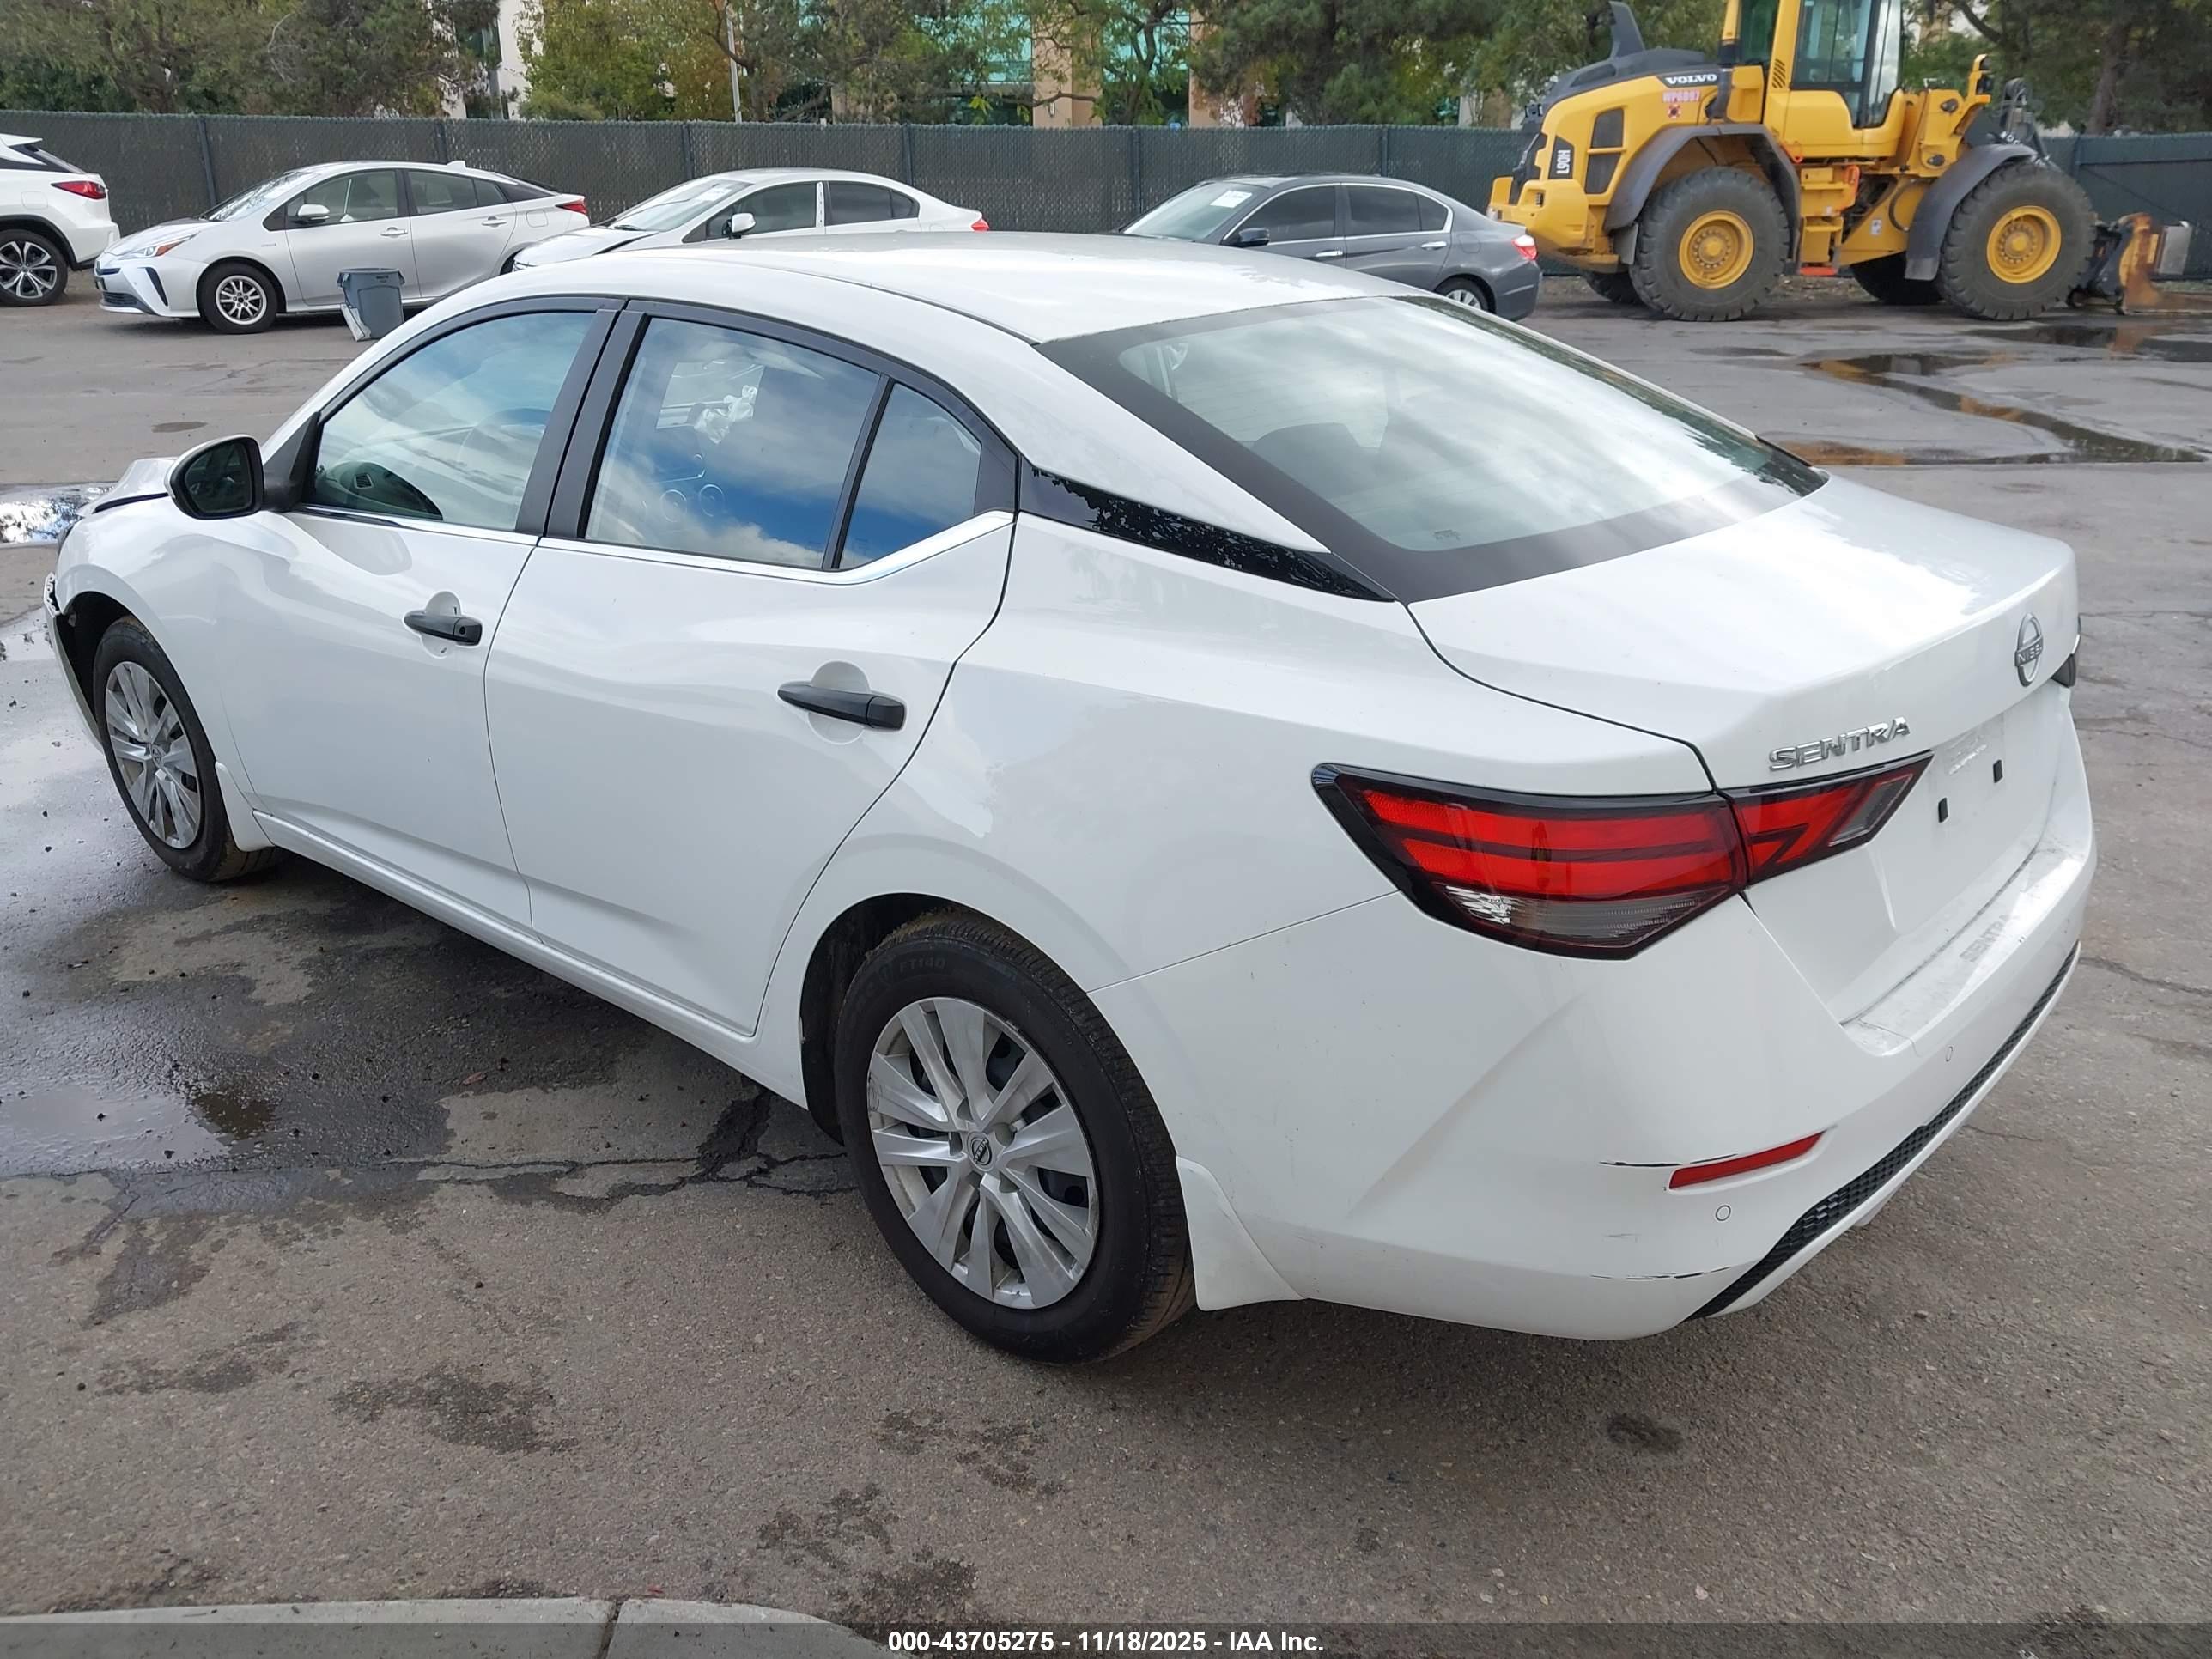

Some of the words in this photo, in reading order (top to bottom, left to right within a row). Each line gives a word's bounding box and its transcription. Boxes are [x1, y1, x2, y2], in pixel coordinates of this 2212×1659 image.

[1665, 74, 1717, 84] VOLVO
[1556, 149, 1571, 174] L90H
[1769, 716, 1911, 771] SENTRA
